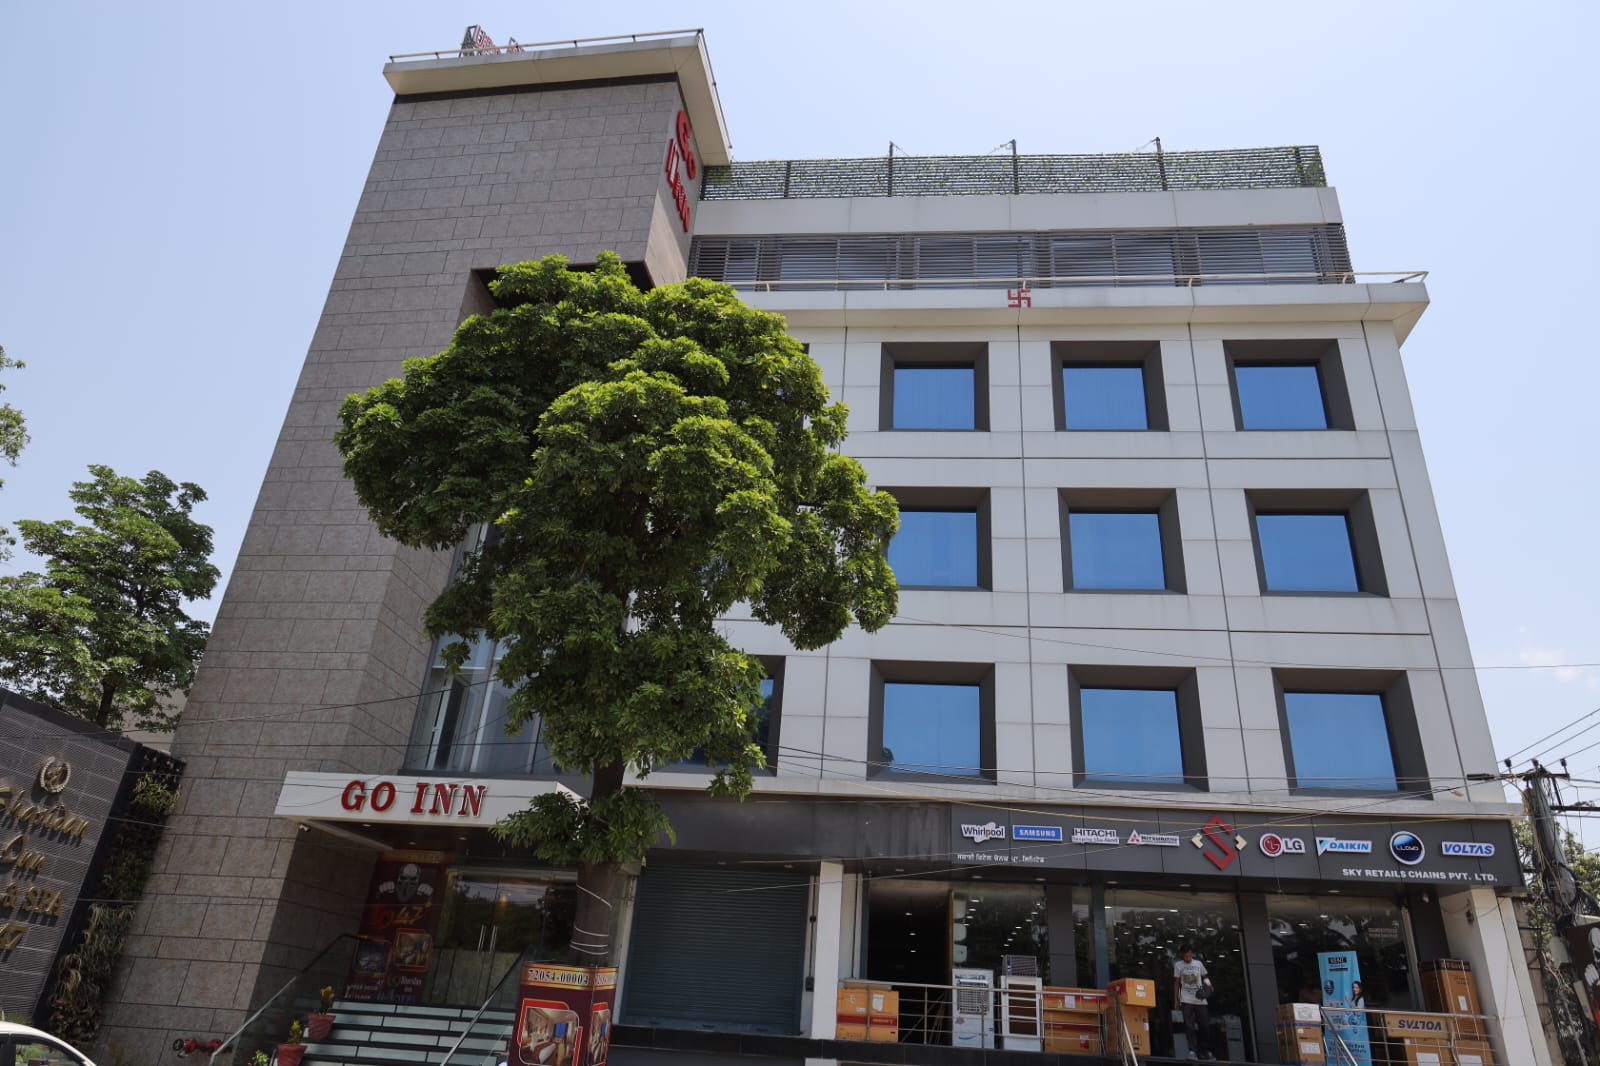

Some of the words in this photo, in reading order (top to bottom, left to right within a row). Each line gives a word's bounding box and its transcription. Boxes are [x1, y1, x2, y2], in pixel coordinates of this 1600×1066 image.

[340, 780, 396, 812] GO
[410, 782, 487, 817] INN
[962, 825, 1004, 839] Whirlpool
[1019, 829, 1056, 837] SAMSUNG
[1075, 828, 1115, 838] HITACHI
[1329, 842, 1369, 850] DAIKIN
[1442, 842, 1494, 856] VOLTAS
[1342, 868, 1363, 876] SKY
[1364, 869, 1407, 878] RETAILS
[1408, 870, 1447, 880] CHAINS
[1449, 872, 1472, 881] PVT.
[1398, 1019, 1442, 1031] VOLTAS
